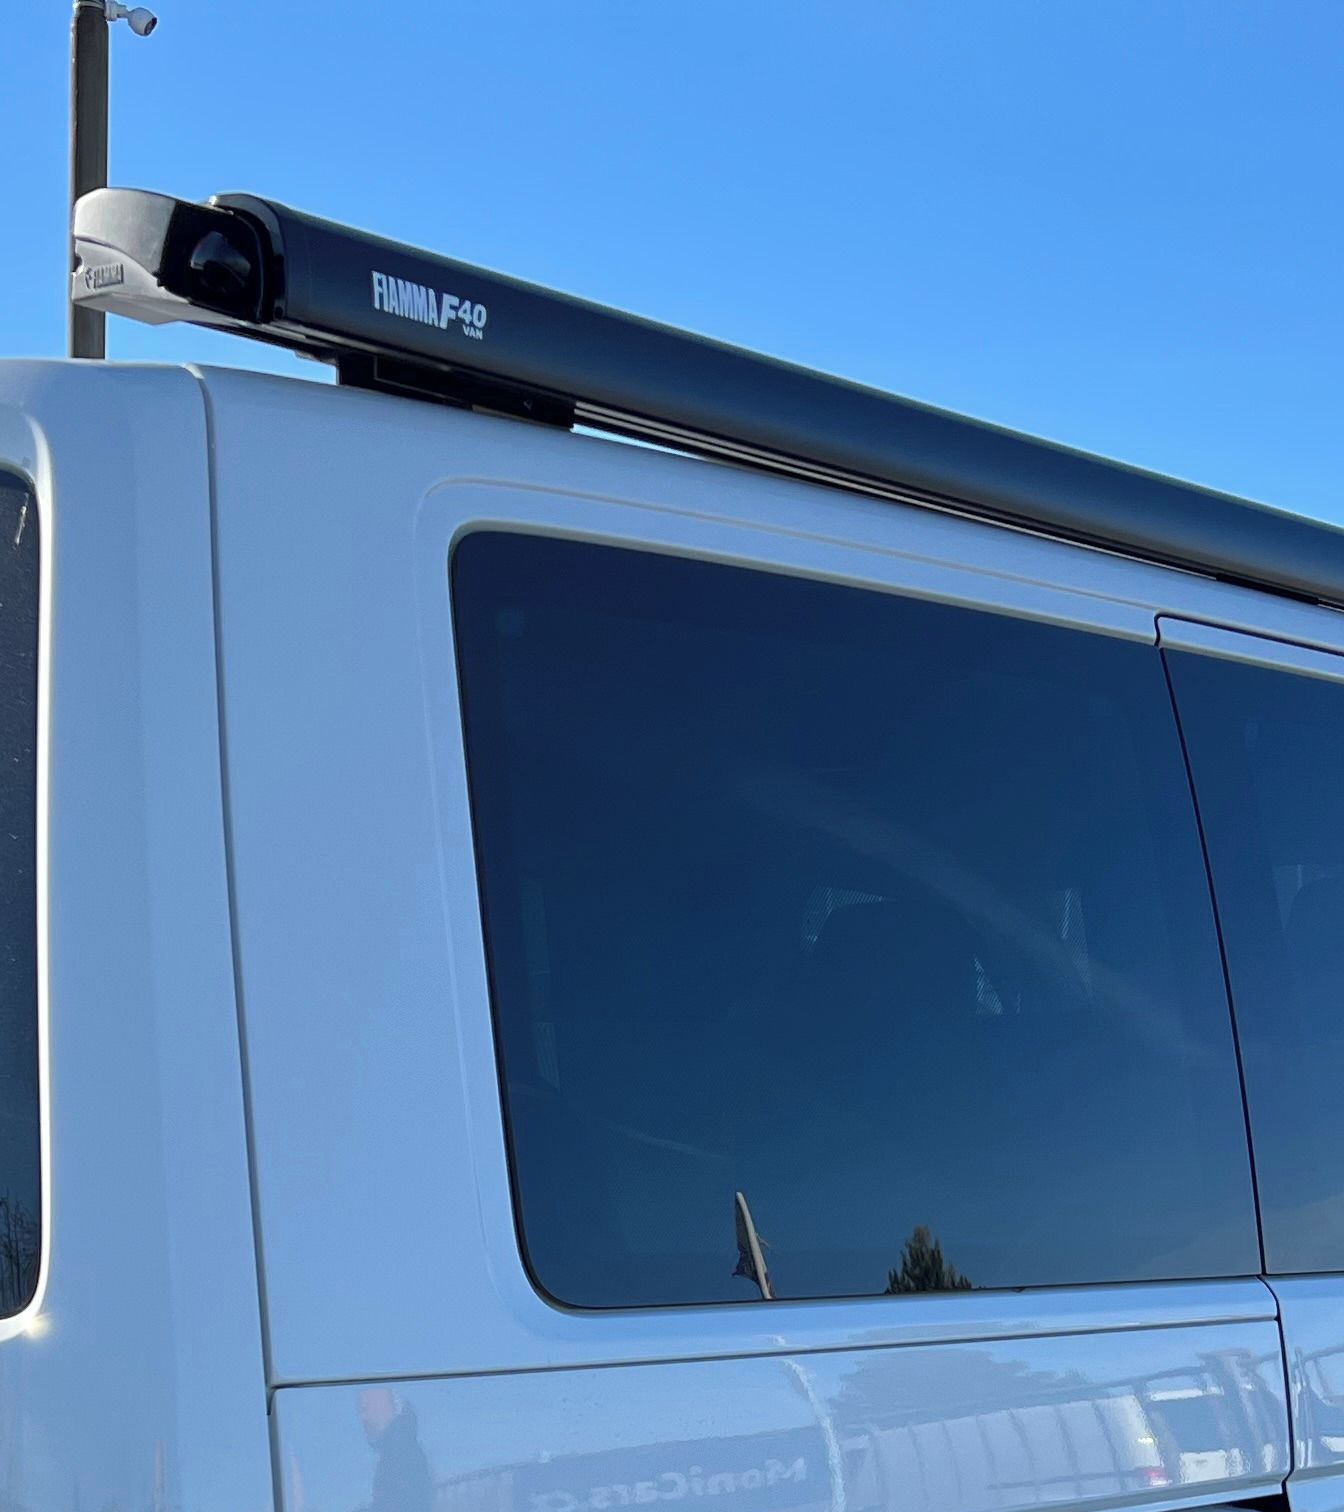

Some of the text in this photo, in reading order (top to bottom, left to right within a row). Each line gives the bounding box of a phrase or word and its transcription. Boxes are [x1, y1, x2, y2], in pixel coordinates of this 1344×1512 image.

[370, 270, 488, 330] FIAMMA F40
[462, 324, 484, 341] VAN
